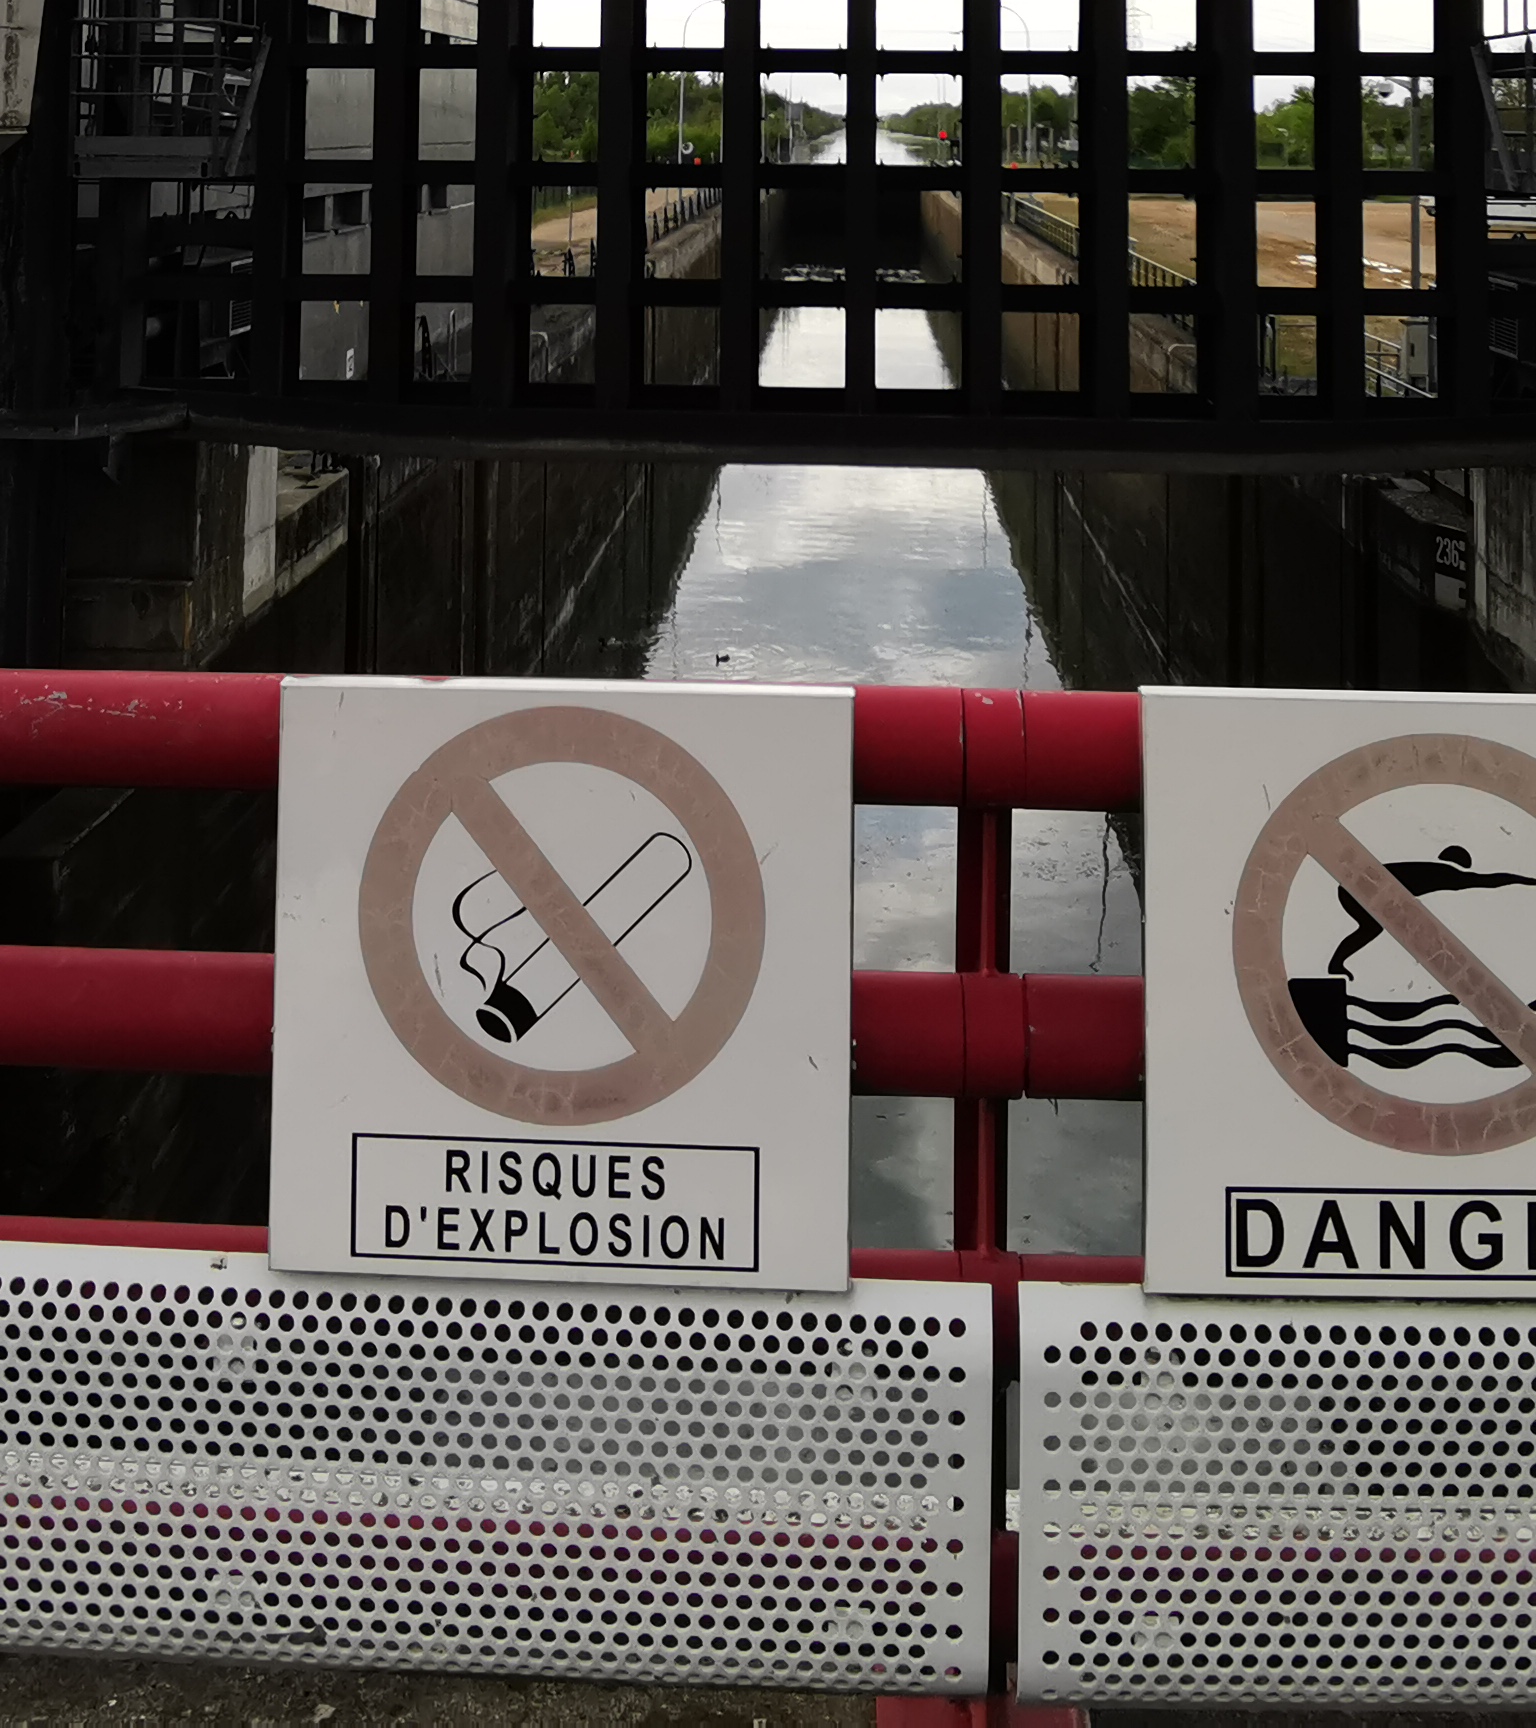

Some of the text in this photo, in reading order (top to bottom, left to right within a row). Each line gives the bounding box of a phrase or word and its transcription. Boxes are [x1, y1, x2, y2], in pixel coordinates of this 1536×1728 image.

[1435, 535, 1460, 568] 236
[445, 1149, 666, 1200] RISQUES
[384, 1204, 725, 1261] D'EXPLOSION
